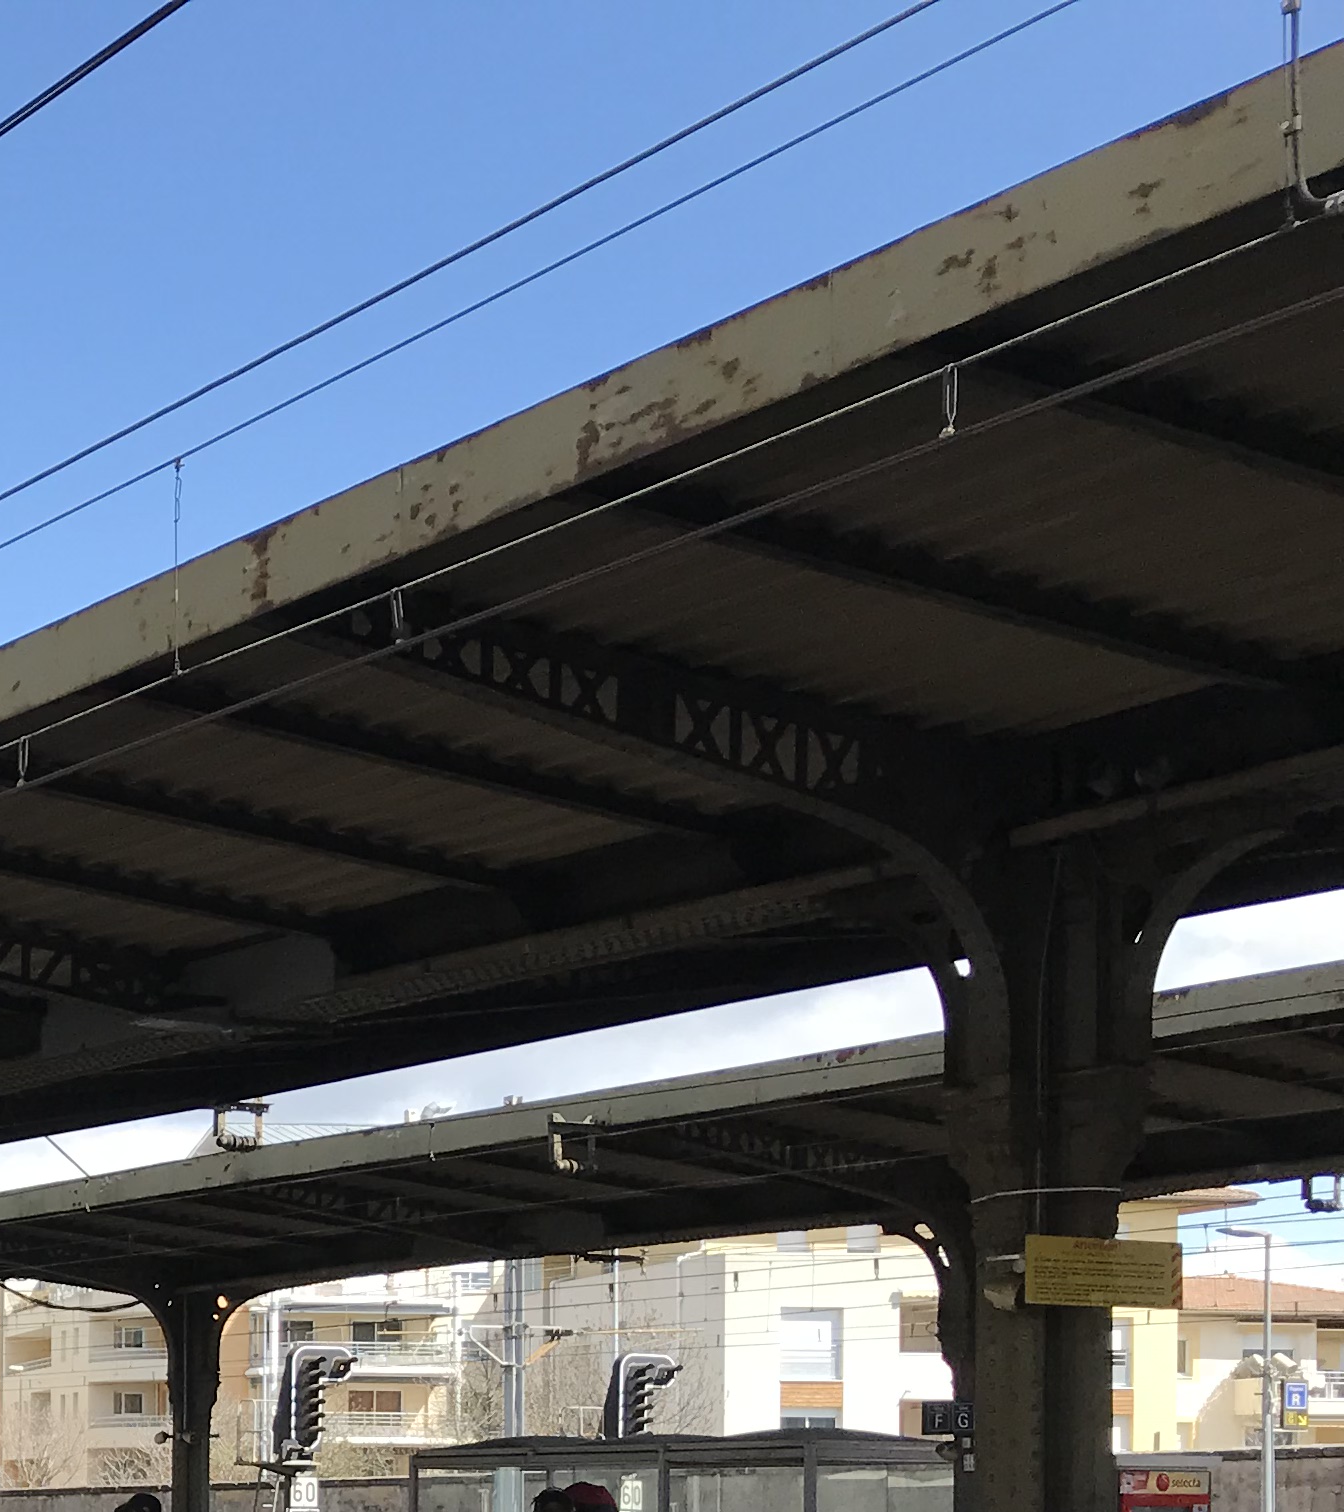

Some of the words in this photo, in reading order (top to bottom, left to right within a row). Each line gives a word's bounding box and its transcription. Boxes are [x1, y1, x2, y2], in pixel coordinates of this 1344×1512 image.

[1291, 1393, 1301, 1406] R
[935, 1414, 943, 1428] F
[958, 1413, 969, 1428] G
[1171, 1477, 1201, 1488] selecta
[293, 1482, 315, 1502] 60
[623, 1485, 641, 1506] 60
